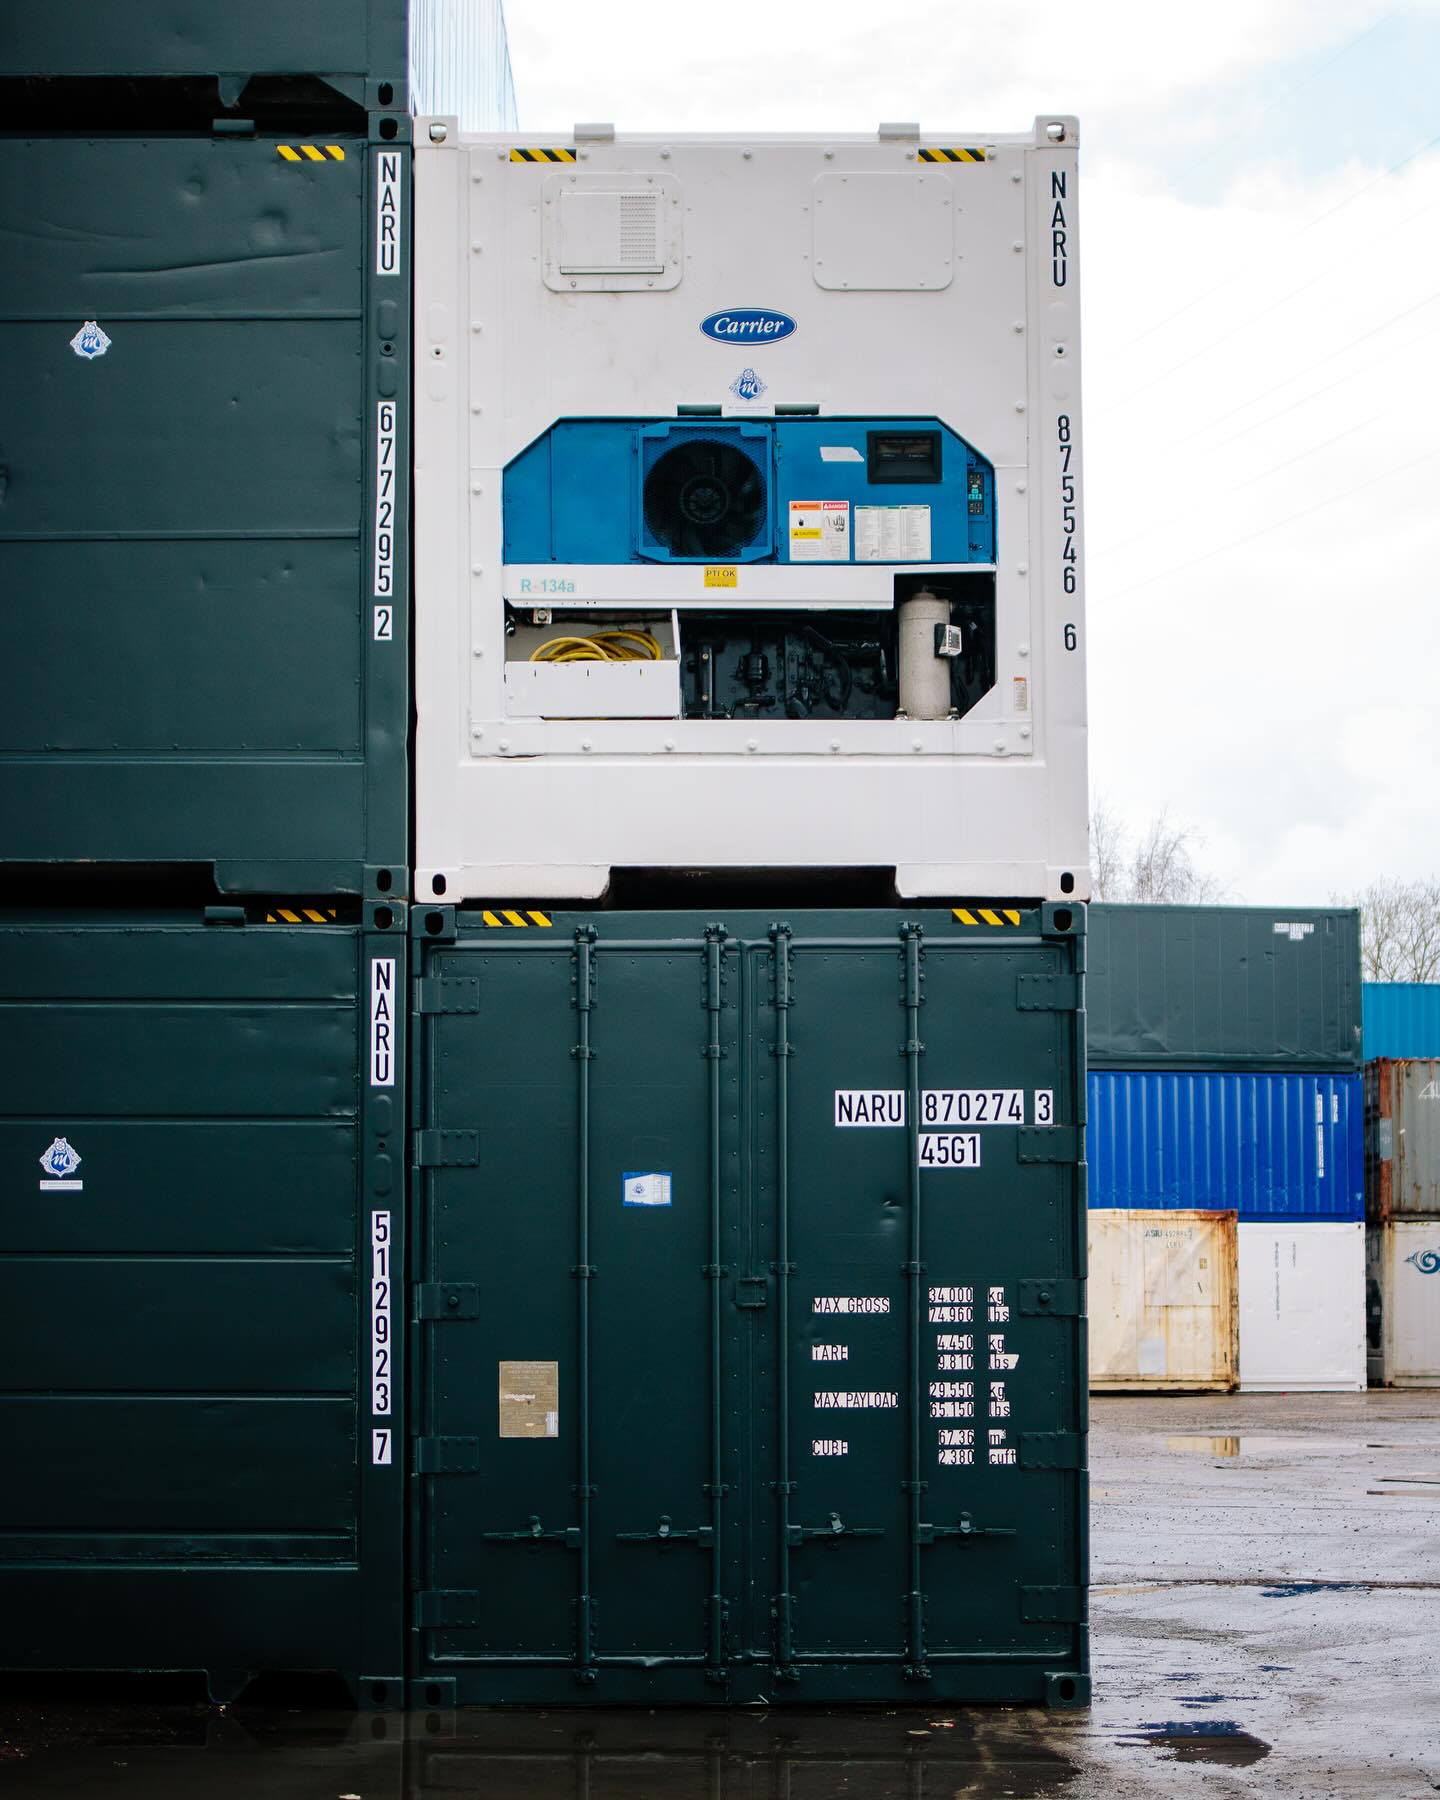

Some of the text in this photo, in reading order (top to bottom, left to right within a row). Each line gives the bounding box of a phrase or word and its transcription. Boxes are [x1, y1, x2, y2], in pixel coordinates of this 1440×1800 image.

[714, 317, 785, 334] Carrier
[377, 155, 396, 637] NARU 677295 2
[1051, 171, 1077, 651] NARU 875546 6
[706, 569, 736, 577] PTI OK
[838, 1093, 1051, 1122] NARU 870274 3
[921, 1136, 977, 1164] 45G1
[375, 962, 391, 1461] NARU 512923 7
[928, 1287, 1004, 1306] 34.000 kg
[928, 1307, 1009, 1322] 74.960 lbs
[812, 1345, 849, 1360] TARE
[937, 1335, 1004, 1354] 4.450 kg
[938, 1354, 1009, 1369] 9.810 lbs
[930, 1382, 1005, 1401] 29.550 kg
[930, 1402, 1011, 1417] 65.150 lbs
[939, 1430, 974, 1445] 67.36
[813, 1440, 849, 1455] CUBE
[939, 1449, 1016, 1464] 2.380 cuft
